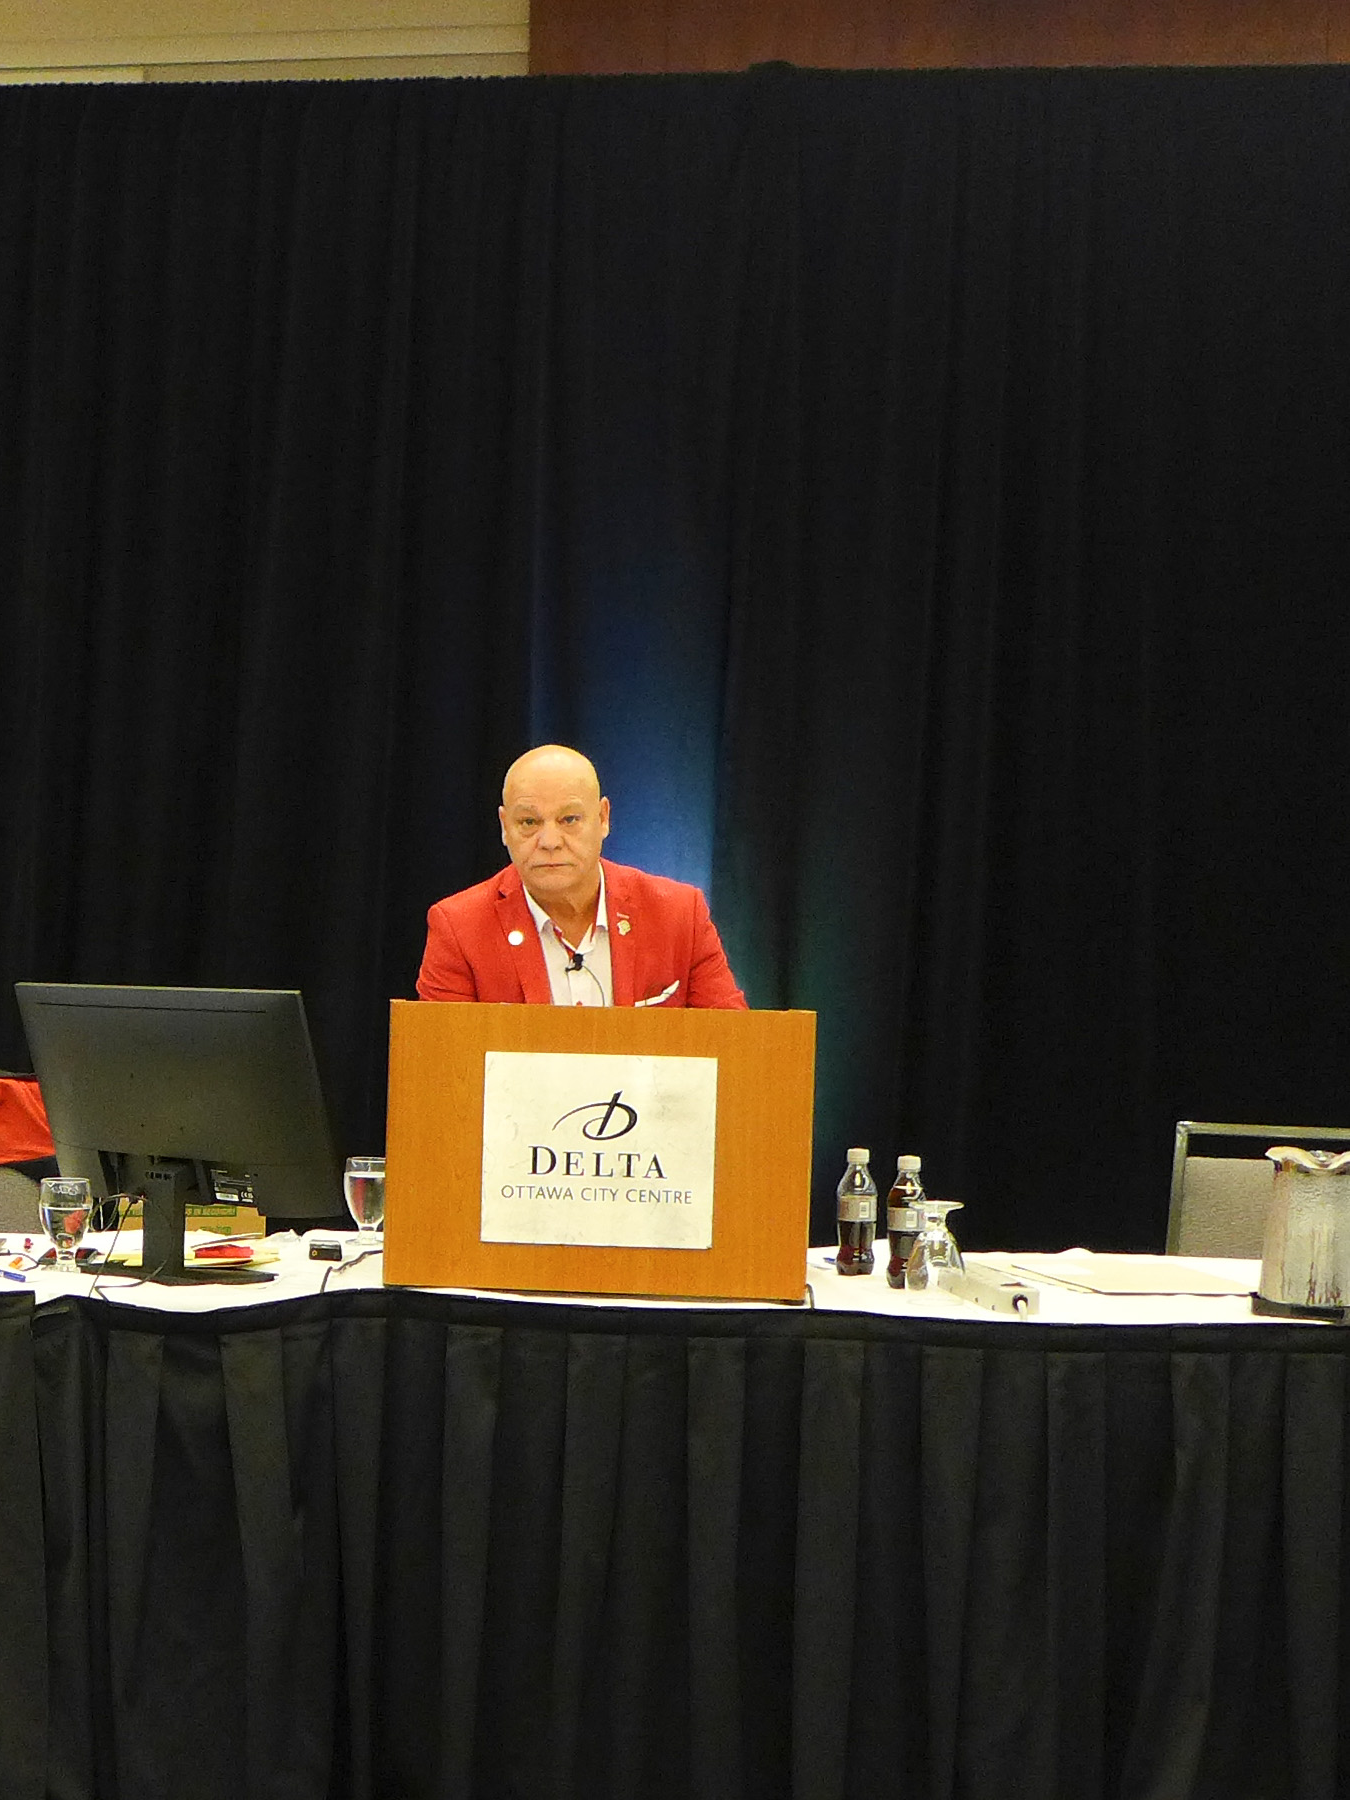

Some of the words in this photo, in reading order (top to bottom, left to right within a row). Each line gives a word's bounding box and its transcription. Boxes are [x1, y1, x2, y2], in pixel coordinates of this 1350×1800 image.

[527, 1145, 667, 1180] DELTA
[501, 1184, 574, 1201] OTTAWA
[581, 1187, 619, 1202] CITY
[626, 1188, 692, 1204] CENTRE
